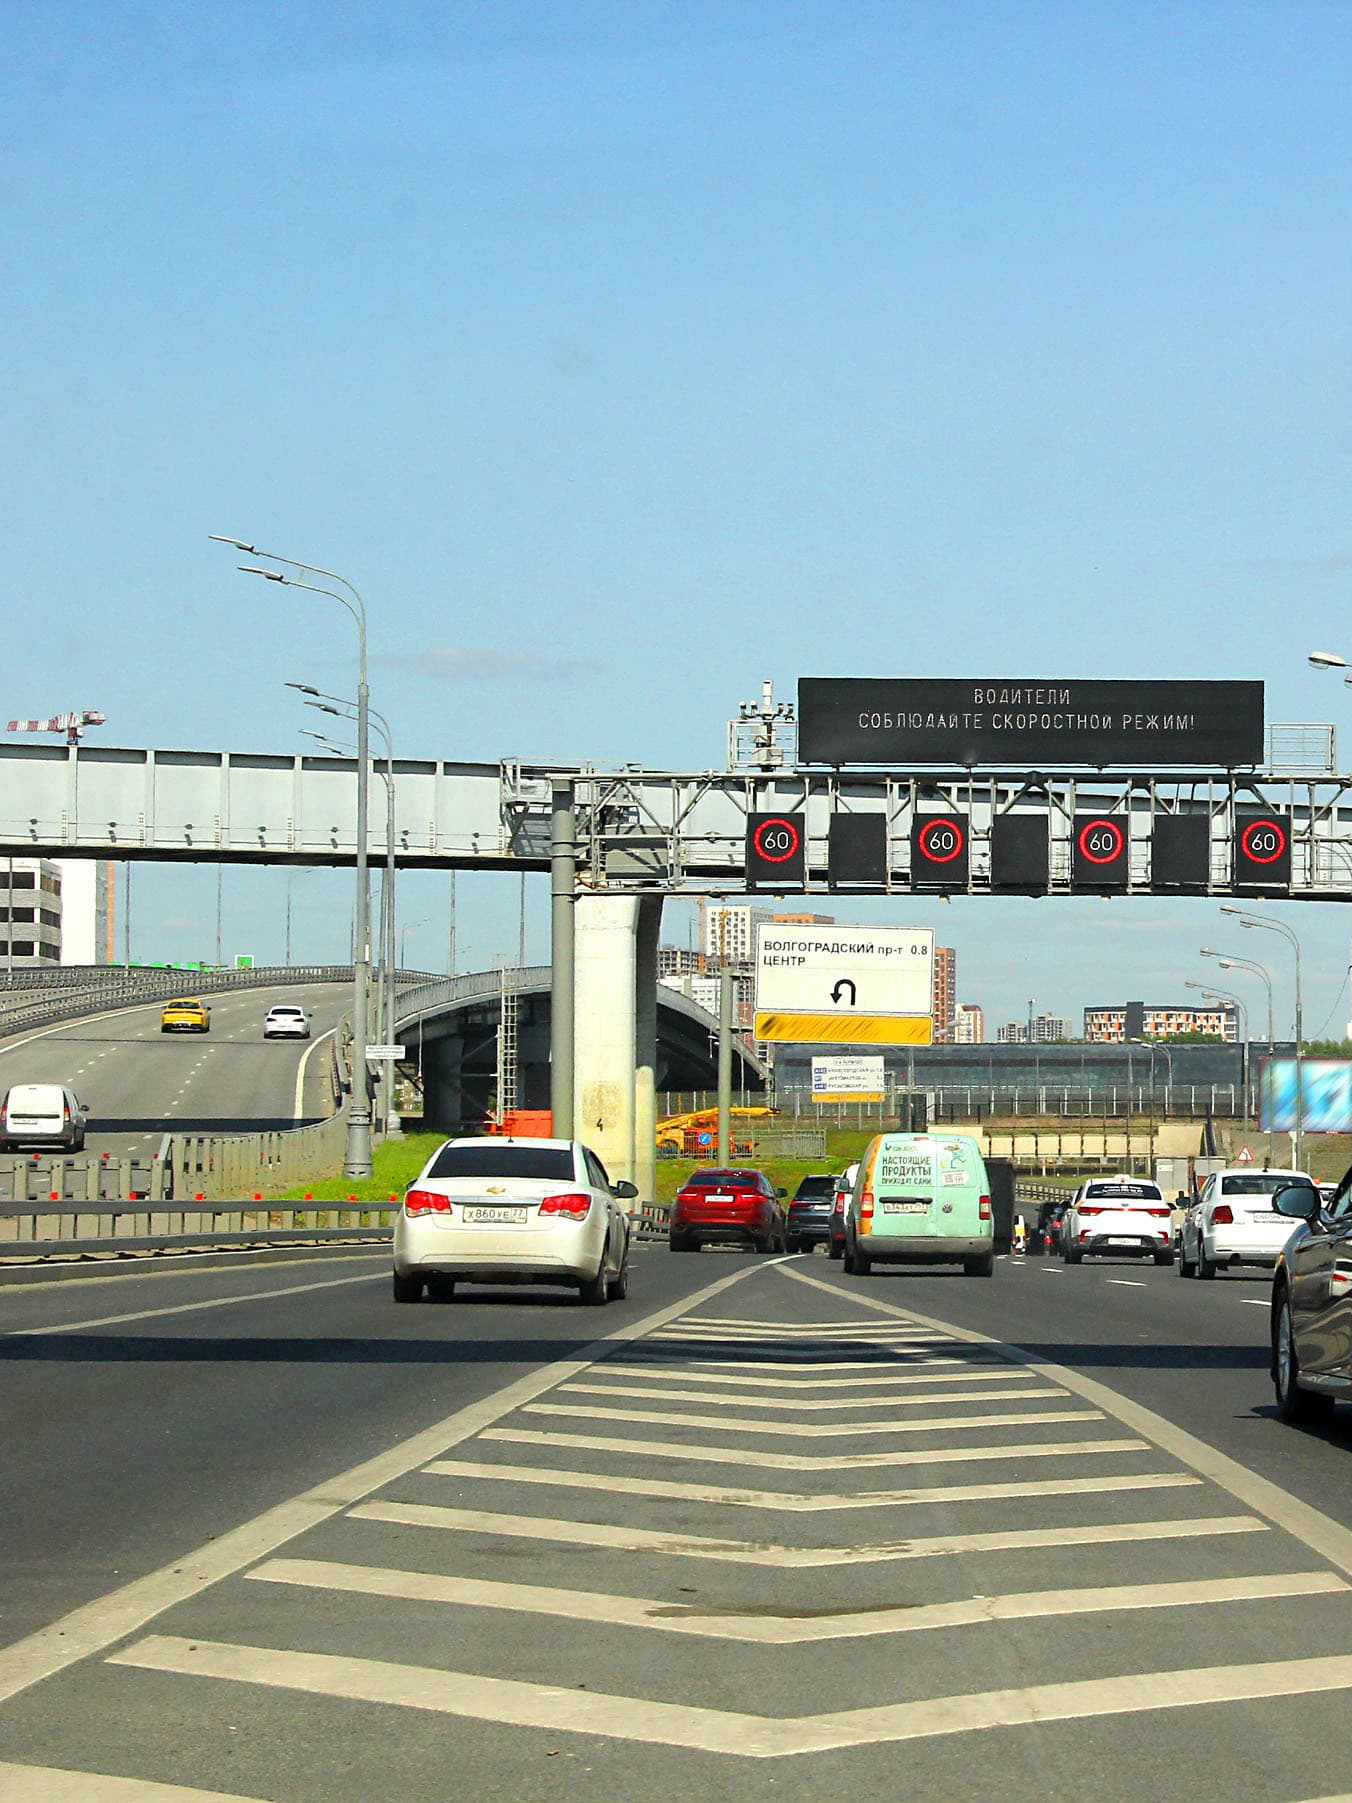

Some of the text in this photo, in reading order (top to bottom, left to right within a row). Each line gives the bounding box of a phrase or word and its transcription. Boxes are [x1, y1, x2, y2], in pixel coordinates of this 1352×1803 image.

[974, 688, 1071, 705] ВОДИТЕЛИ
[858, 712, 1195, 730] СОБЛЮДАЙТЕ СКОРОСТНОЙ РЕЖИМ!
[764, 831, 789, 850] 60
[929, 831, 954, 850] 60
[1089, 833, 1113, 851] 60
[1251, 833, 1276, 851] 60
[764, 941, 928, 956] ВОЛГОГРАДСКИЙ пр-т 0.8
[763, 955, 806, 967] ЦЕНТР
[882, 1156, 931, 1165] НАСТОЯЩИЕ
[882, 1165, 931, 1176] ПРОДУКТЫ
[512, 1208, 524, 1217] 77
